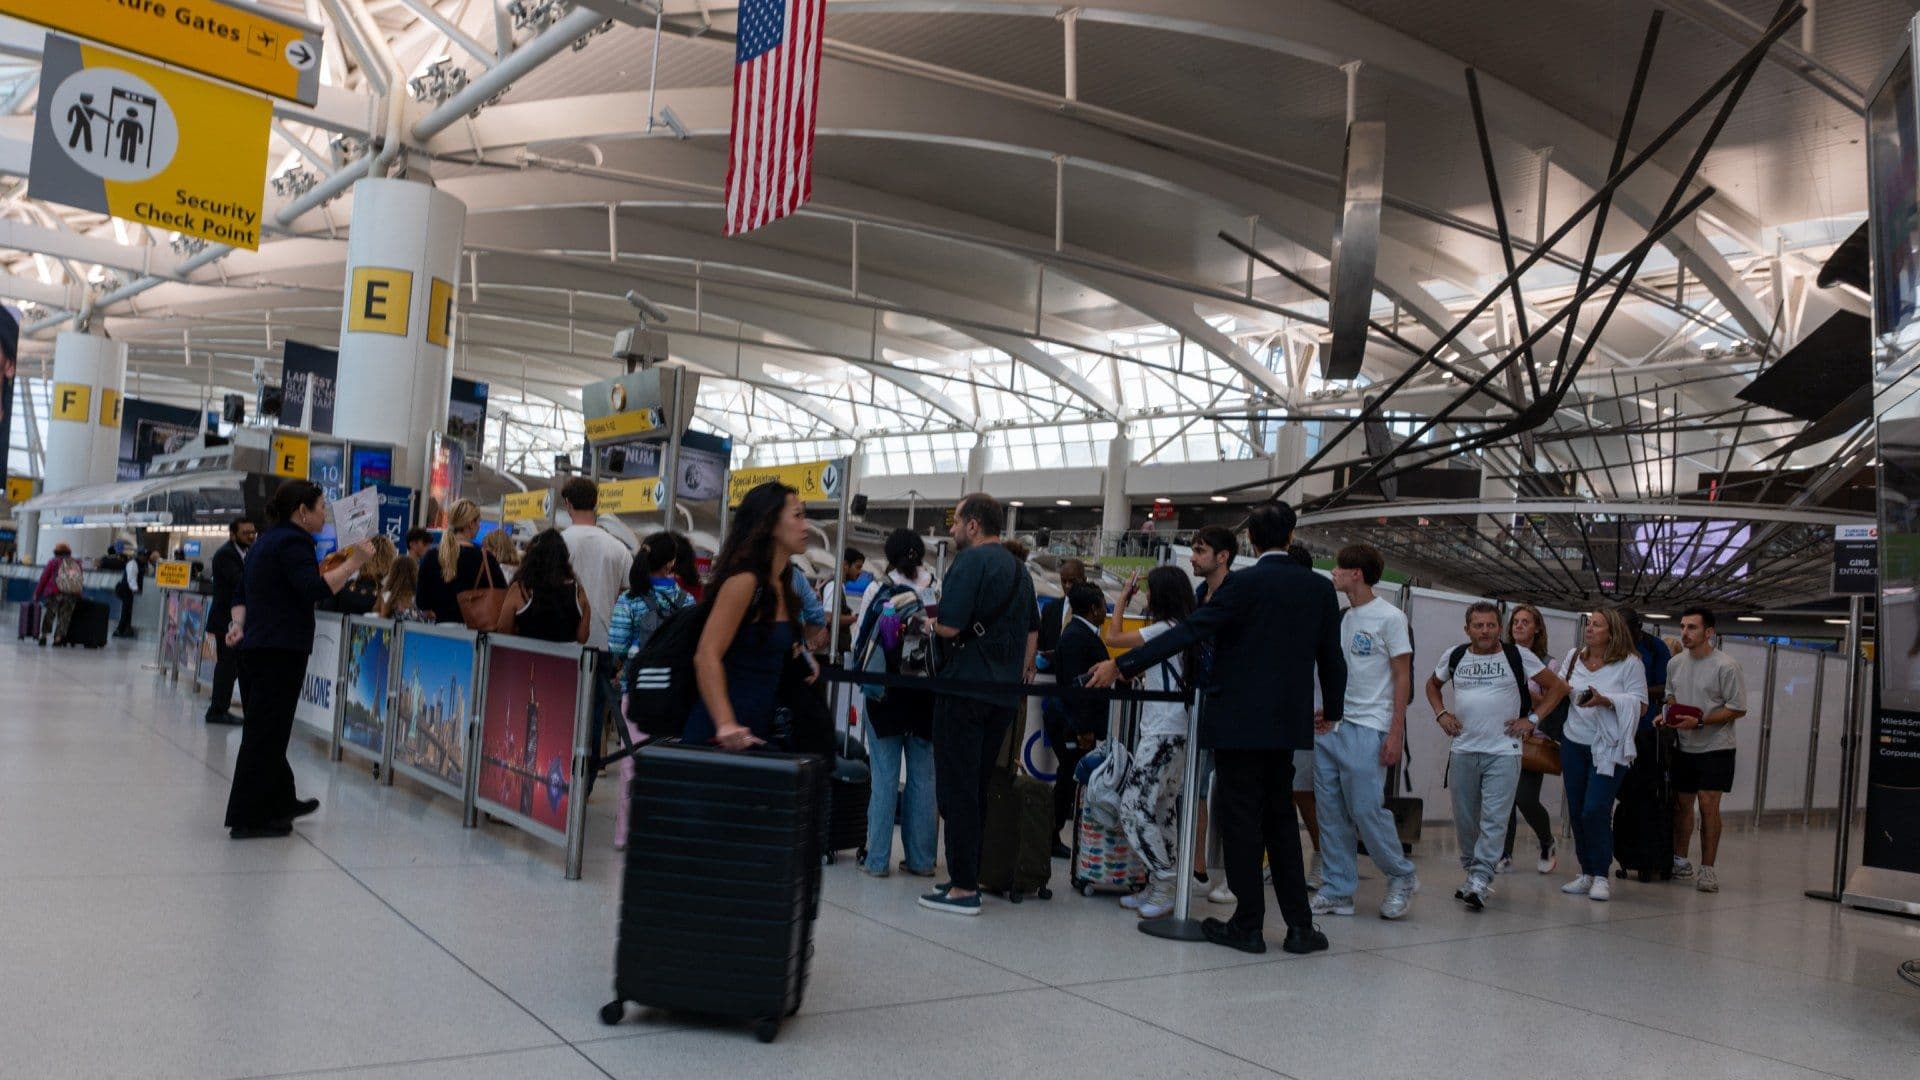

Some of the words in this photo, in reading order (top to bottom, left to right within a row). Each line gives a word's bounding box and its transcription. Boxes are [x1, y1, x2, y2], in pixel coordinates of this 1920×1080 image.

[108, 0, 166, 17] ture
[175, 7, 241, 41] Gates
[176, 189, 257, 226] Security
[134, 201, 195, 229] Check
[203, 217, 254, 244] Point
[364, 280, 389, 320] E
[286, 370, 333, 389] LAREST
[285, 380, 323, 398] GLOAL
[62, 390, 77, 413] F
[284, 391, 332, 409] PRORAM
[284, 455, 296, 472] E
[322, 465, 338, 482] 10
[733, 473, 752, 486] Special
[1472, 662, 1505, 677] Dutch
